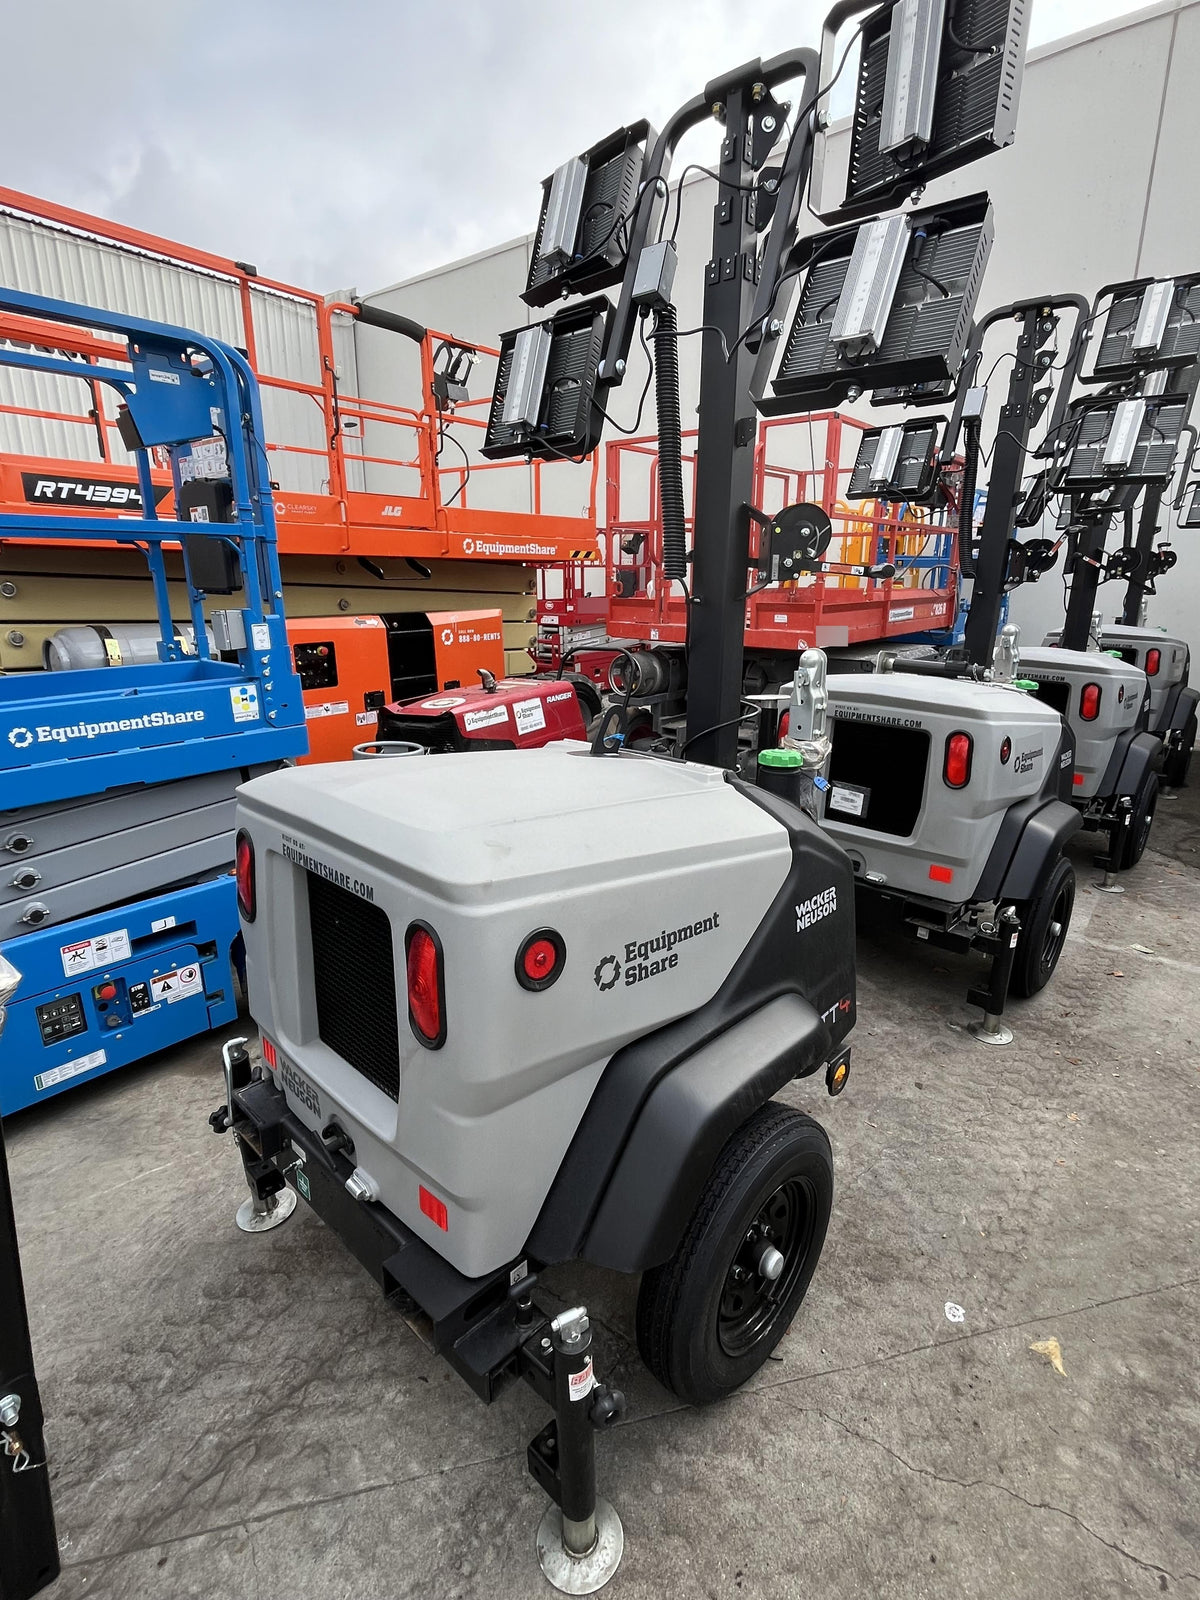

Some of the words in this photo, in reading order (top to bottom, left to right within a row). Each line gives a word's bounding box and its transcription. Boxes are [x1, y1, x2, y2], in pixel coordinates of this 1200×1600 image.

[34, 480, 142, 504] RT4394
[381, 505, 403, 517] JLG
[475, 540, 557, 556] EquipmentShare
[547, 692, 573, 703] RANGER
[36, 710, 205, 743] EquipmentShare
[834, 709, 923, 728] EQUIPMENTSHARE.COM
[282, 843, 375, 902] EQUIPMENTSHARE.COM
[794, 886, 837, 918] WACKER
[796, 898, 837, 933] NEUSON
[624, 911, 720, 964] Equipment
[624, 953, 679, 987] Share
[280, 1055, 320, 1107] WACKER
[281, 1070, 322, 1120] NEUSON
